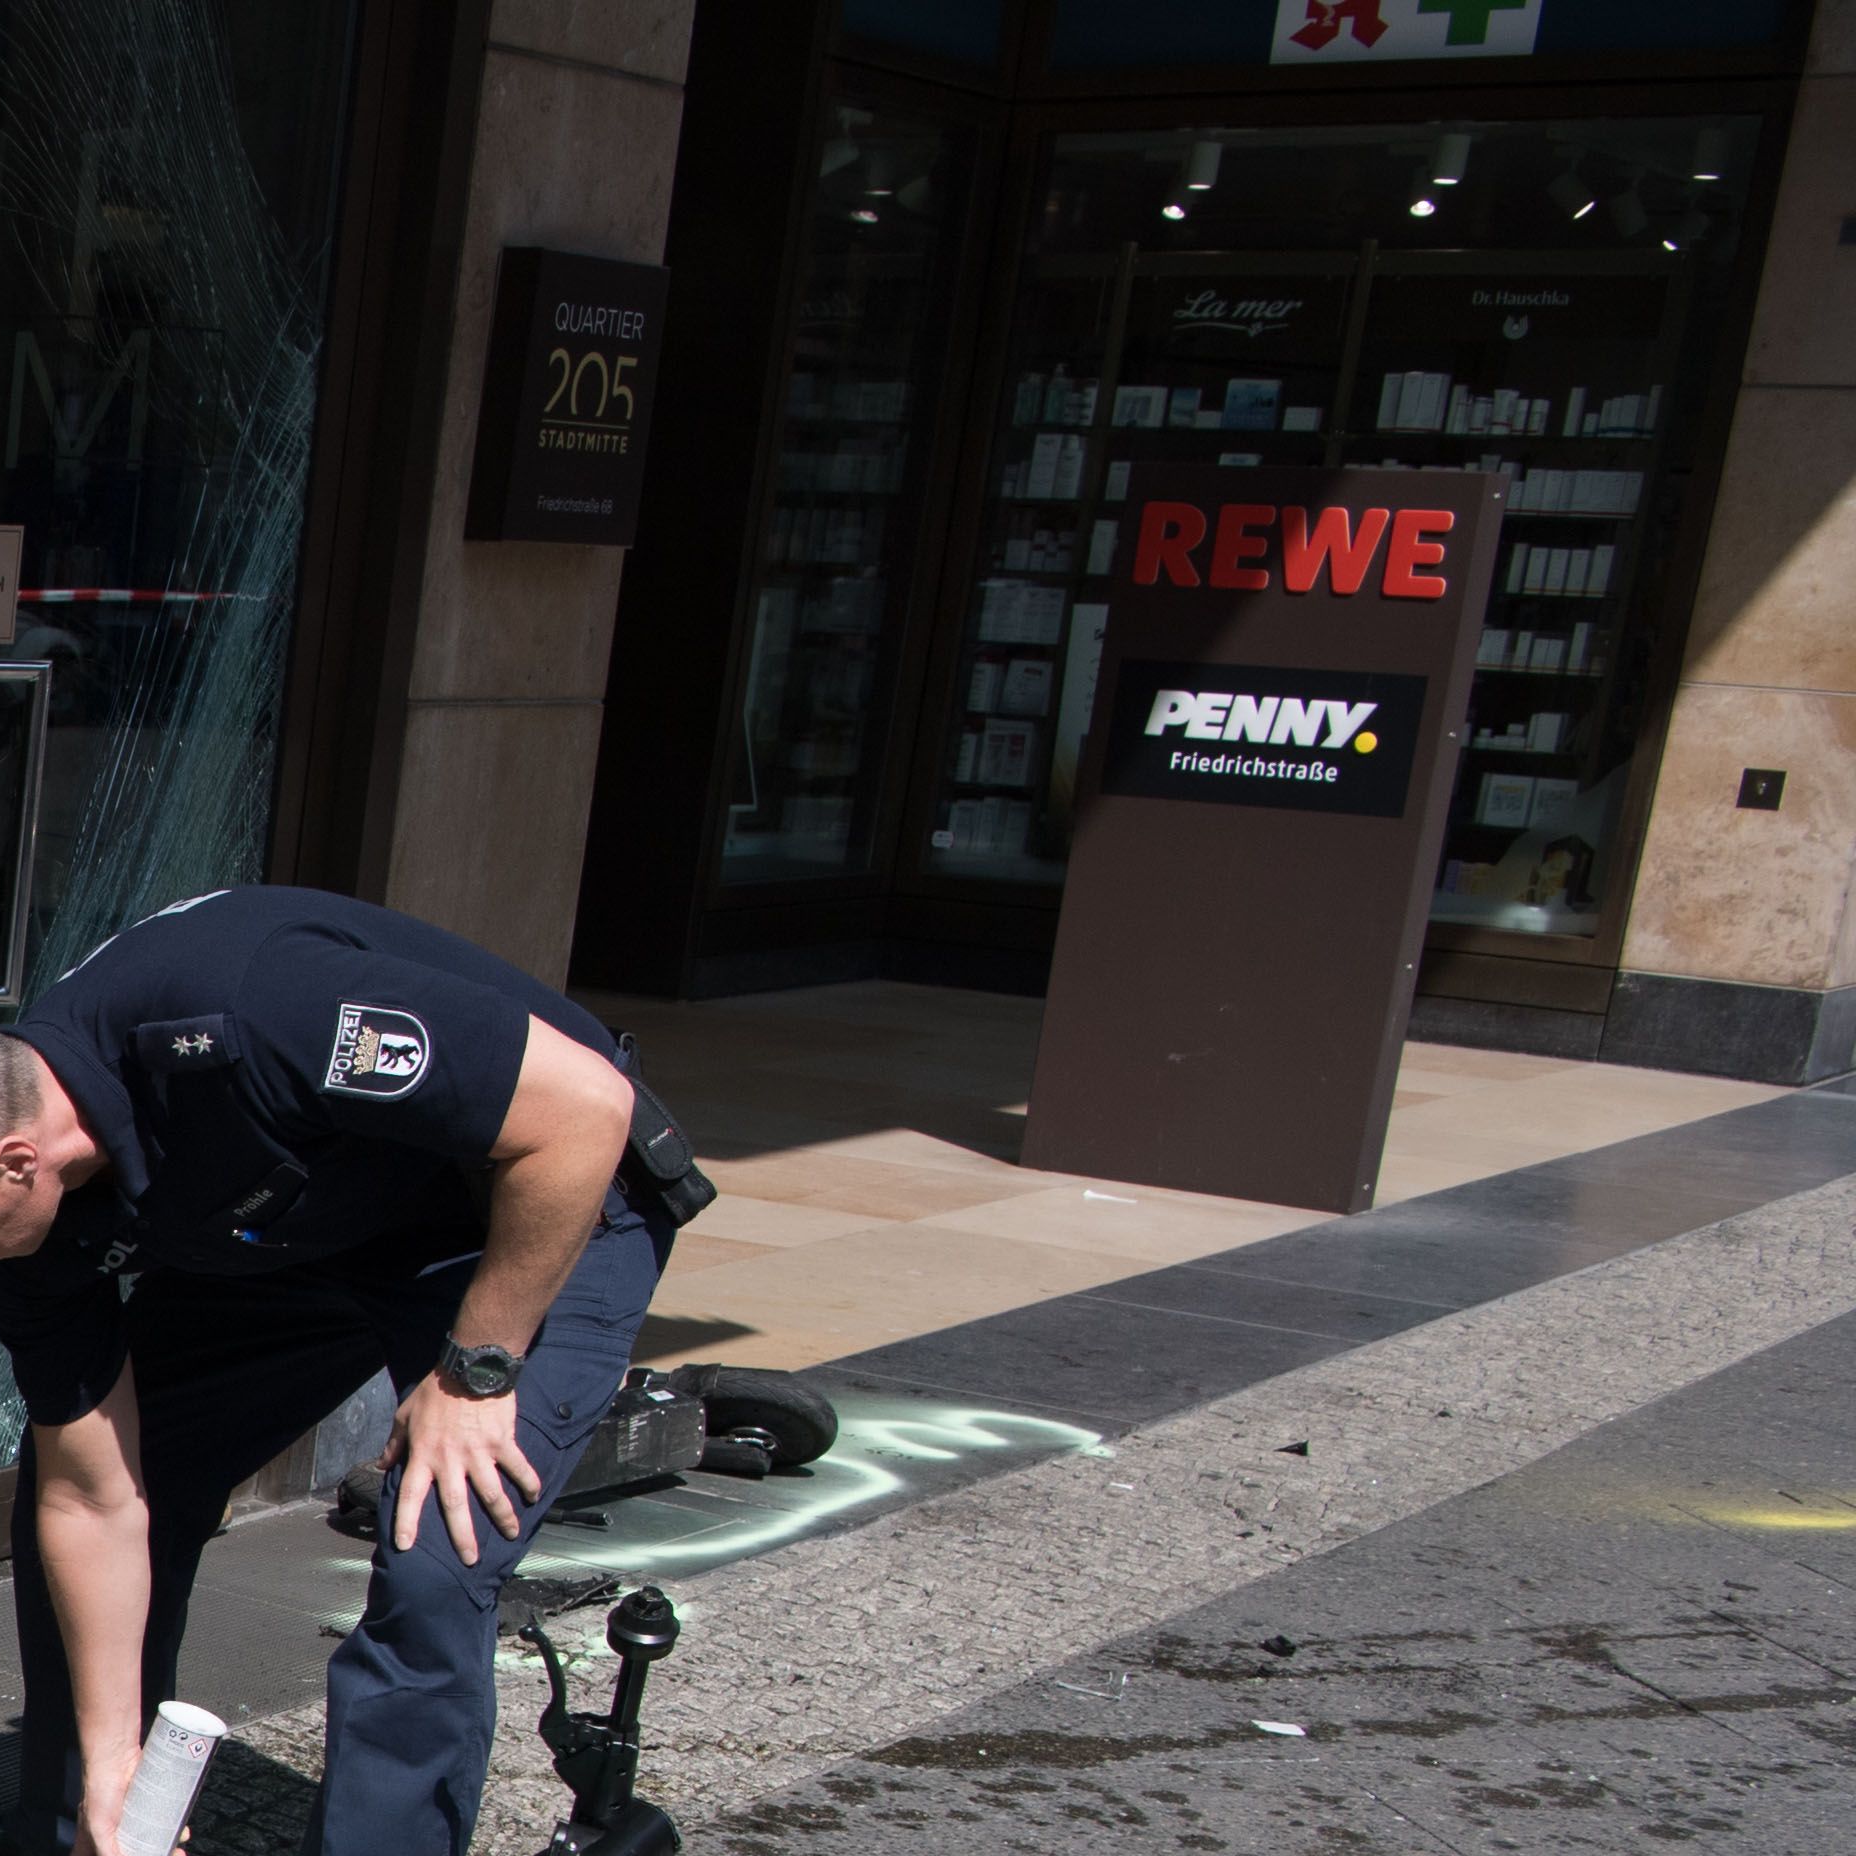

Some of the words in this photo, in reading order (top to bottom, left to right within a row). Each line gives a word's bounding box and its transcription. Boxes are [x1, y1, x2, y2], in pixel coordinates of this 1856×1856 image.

[1471, 289, 1494, 306] Dr.
[1496, 289, 1571, 307] Hauschka
[554, 301, 645, 341] QUARTIER
[543, 347, 639, 421] 205
[538, 428, 629, 455] STADTMITTE
[1132, 500, 1457, 600] REWE
[1169, 751, 1338, 784] Friedrichstraße
[330, 1010, 363, 1085] POLIZEI
[232, 1187, 274, 1220] Pröhle
